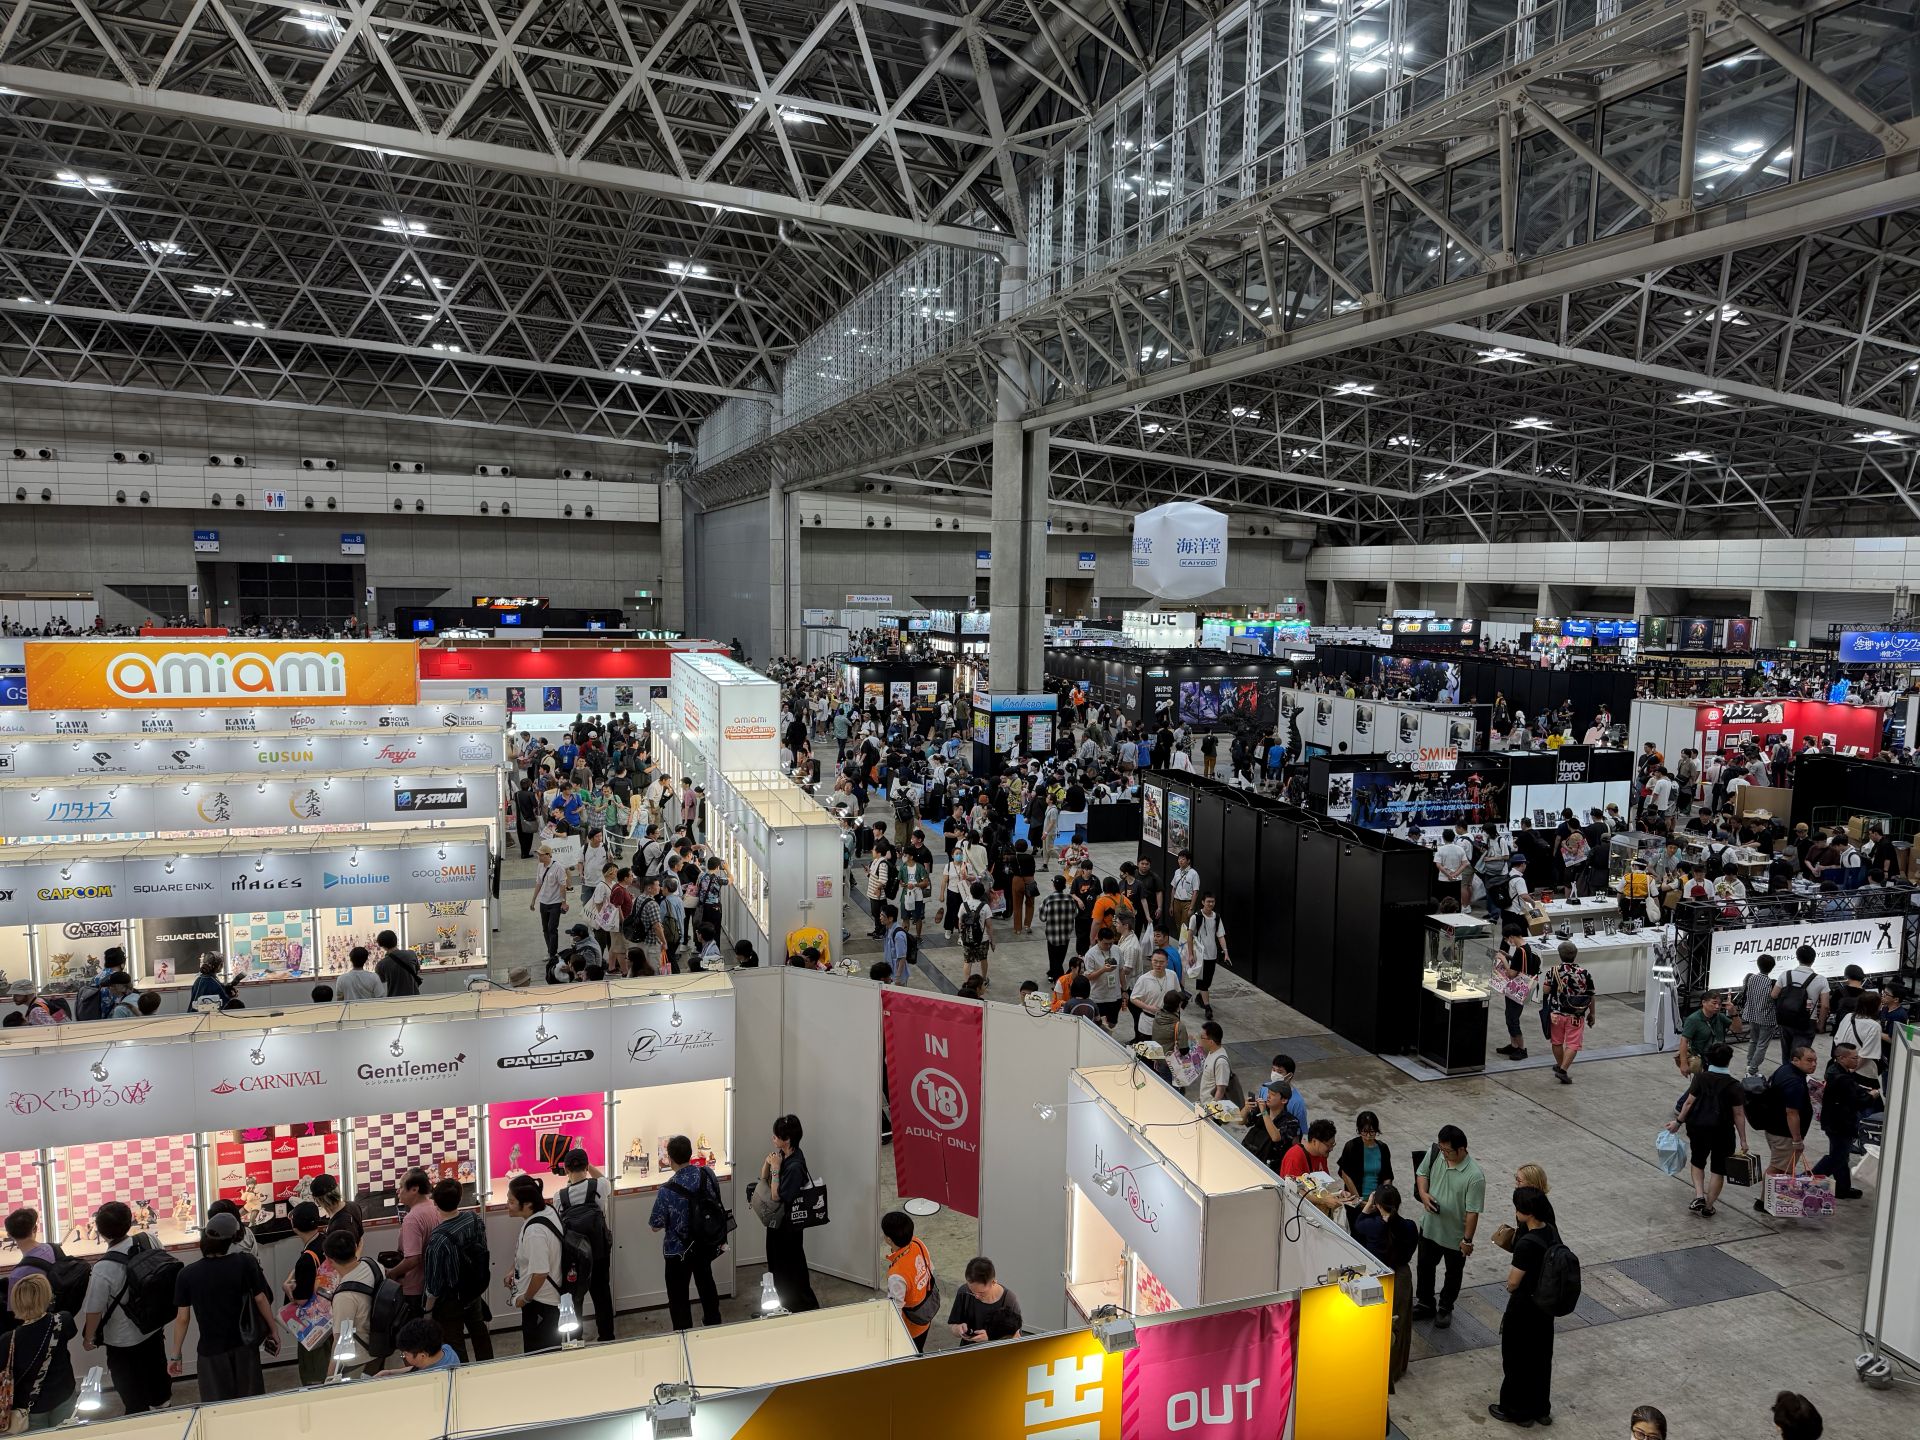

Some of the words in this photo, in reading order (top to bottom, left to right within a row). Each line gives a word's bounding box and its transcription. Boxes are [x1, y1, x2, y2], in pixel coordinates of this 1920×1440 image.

[1177, 538, 1221, 554] 海洋堂
[109, 653, 345, 695] amiami
[1722, 704, 1754, 718] ガメラ
[56, 721, 88, 729] KAWA
[141, 719, 174, 727] KAWA
[225, 718, 256, 726] KAWA
[734, 716, 767, 724] amiami
[724, 726, 752, 734] Hobby
[258, 751, 314, 763] EUSUN
[1387, 752, 1419, 762] GOOD
[1420, 747, 1458, 760] SMILE
[1411, 761, 1457, 770] COMPANY
[1559, 760, 1586, 772] three
[1558, 771, 1581, 782] zero
[414, 792, 465, 810] T-SPARK
[46, 801, 115, 820] ノクタナス
[411, 869, 440, 878] GOOD
[441, 864, 476, 877] SMILE
[340, 873, 390, 885] hololive
[434, 875, 477, 884] COMPANY
[37, 885, 113, 900] CAPCOM
[133, 883, 184, 893] SQUARE
[63, 921, 121, 939] CAPCOM
[156, 933, 195, 942] SQUARE
[1733, 936, 1800, 955] PATLABOR
[1802, 930, 1872, 948] EXHIBITION
[924, 1032, 949, 1059] IN
[503, 1051, 589, 1068] PANDORA
[239, 1070, 328, 1093] CARNIVAL
[922, 1081, 958, 1118] 18
[505, 1111, 587, 1127] PANDORA
[905, 1126, 943, 1143] ADULT
[947, 1136, 977, 1153] ONLY
[1023, 1353, 1105, 1440] 出
[1166, 1377, 1261, 1432] OUT
